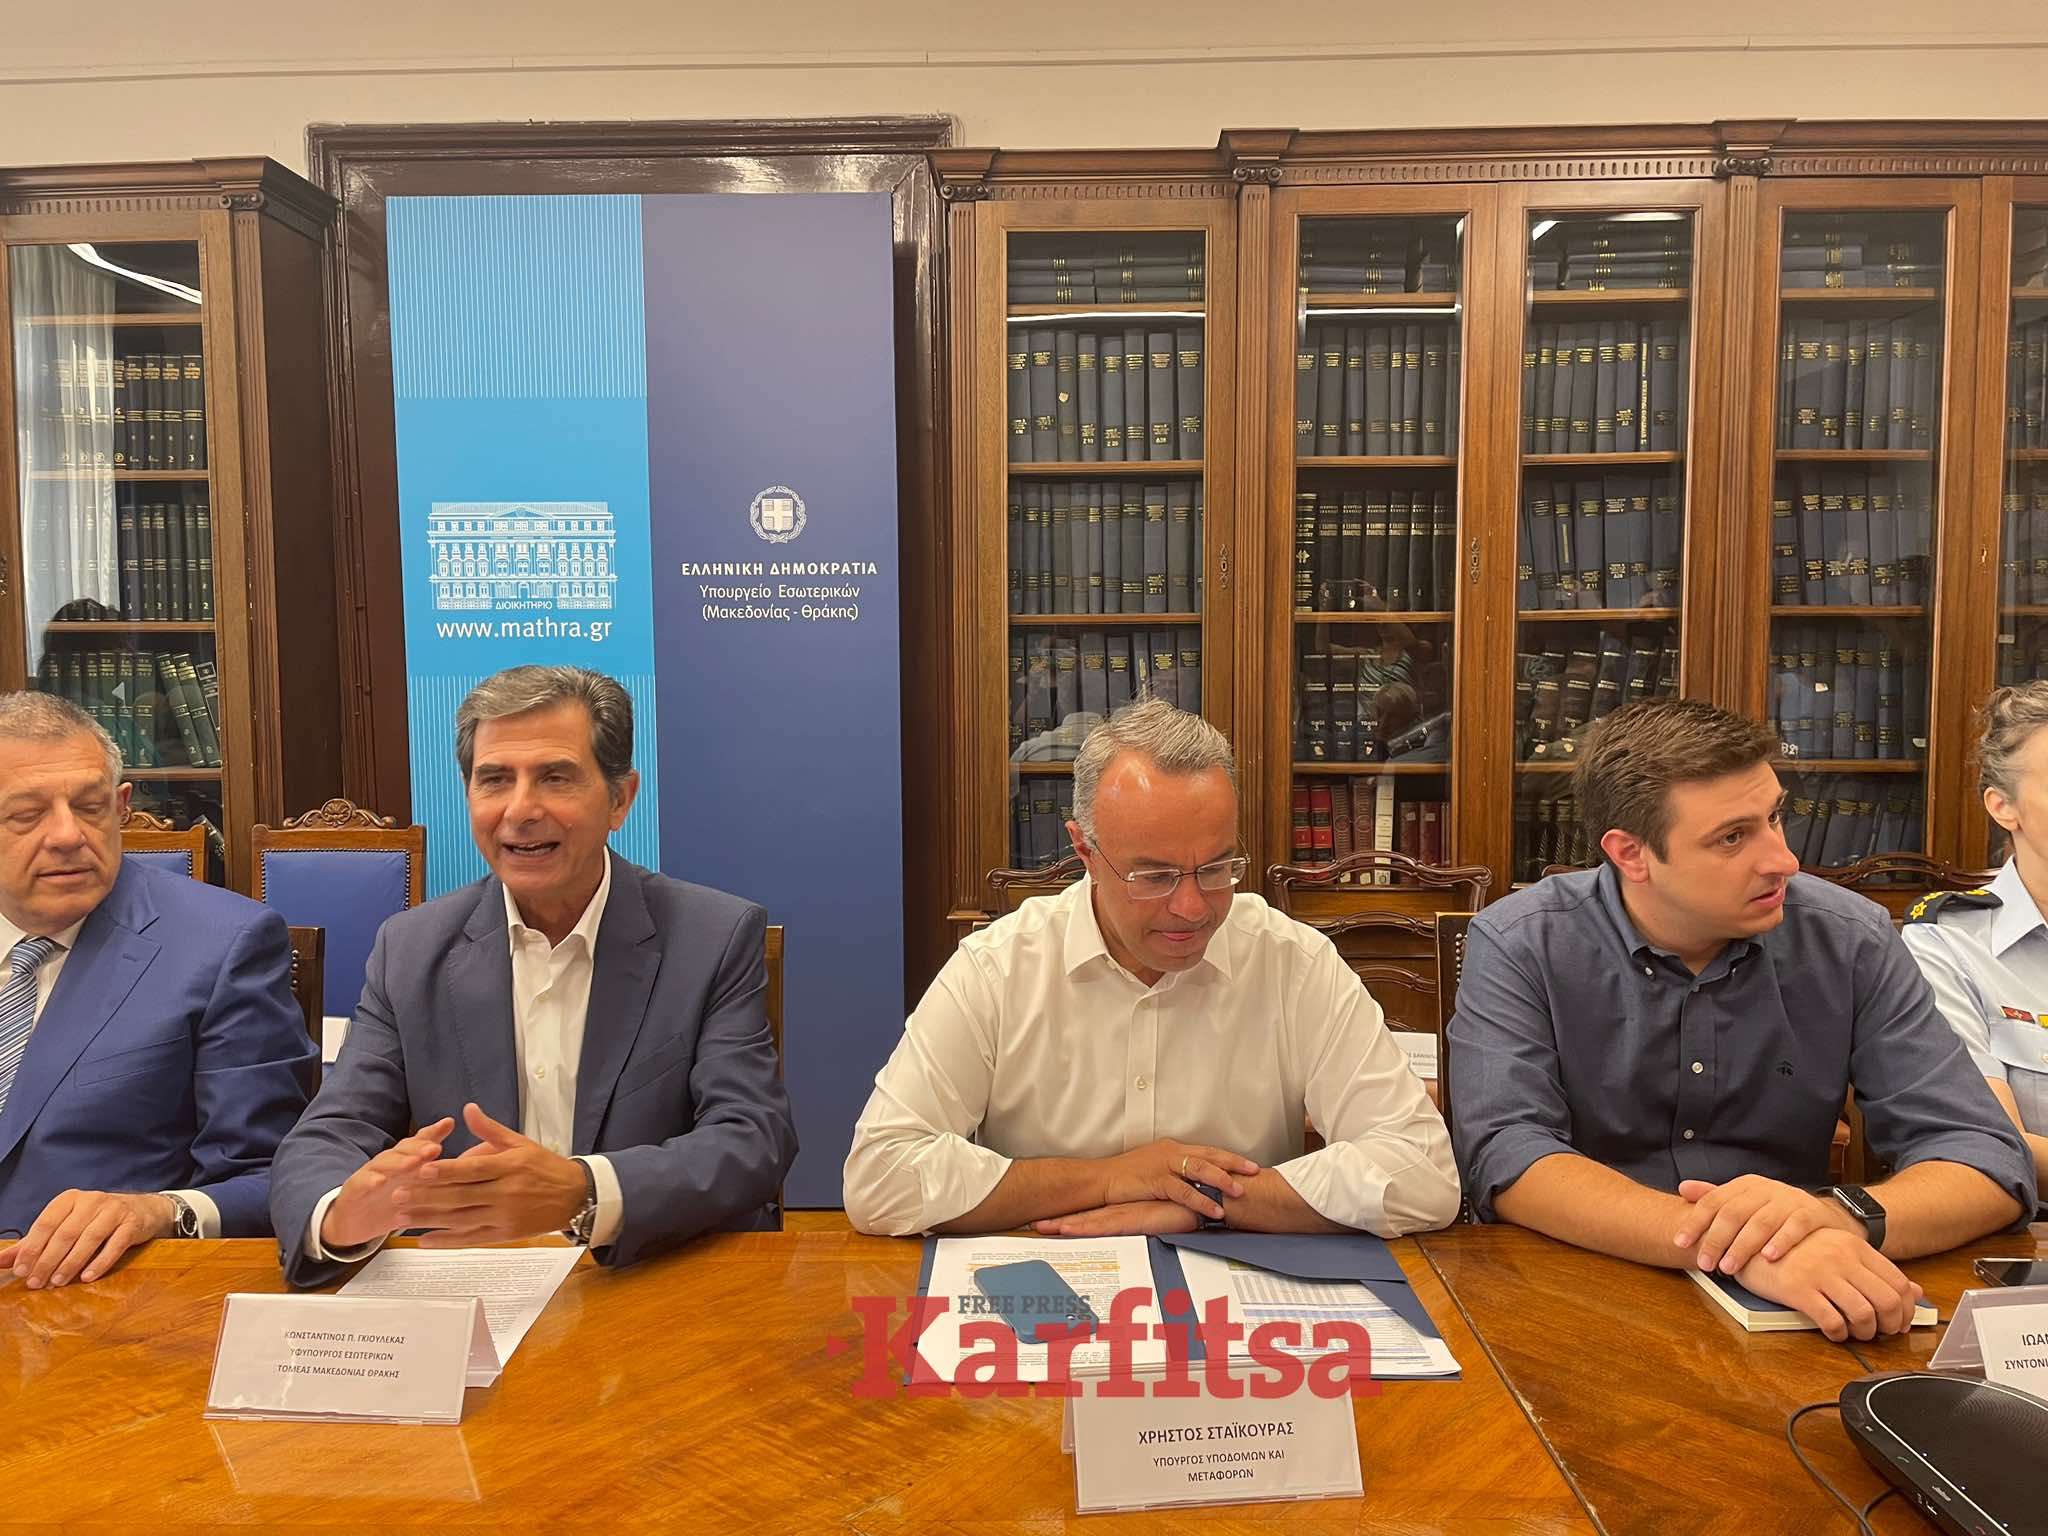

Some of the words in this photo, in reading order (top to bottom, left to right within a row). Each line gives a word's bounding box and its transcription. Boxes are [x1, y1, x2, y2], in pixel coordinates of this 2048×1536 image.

[681, 562, 763, 576] ΕΛΛΗΝΙΚΗ
[770, 562, 878, 575] ΔΗΜΟΚΡΑΤΙΑ
[699, 583, 772, 601] Υπουργείο
[778, 582, 860, 600] Εσωτερικών
[495, 601, 553, 610] ΔΙΟΙΚΗΤΗΡΙΟ
[702, 604, 790, 622] (Μακεδονίας
[801, 604, 859, 622] Θράκης)
[436, 616, 612, 642] www.mathra.gr
[358, 1334, 406, 1344] ΓΚΙΟΥΛΕΚΑΣ
[344, 1351, 394, 1360] ΕΣΩΤΕΡΙΚΩΝ
[278, 1364, 311, 1374] ΤΟΜΕΑΣ
[312, 1366, 366, 1376] ΜΑΚΕΔΟΝΙΑΣ
[1138, 1427, 1204, 1444] ΧΡΗΣΤΟΣ
[1207, 1421, 1294, 1440] ΣΤΑΪΚΟΥΡΑΣ
[1153, 1454, 1204, 1468] ΥΠΟΥΡΓΟΣ
[1206, 1450, 1266, 1464] ΥΠΟΔΟΜΩΝ
[1268, 1450, 1285, 1460] ΚΑΙ
[1188, 1469, 1254, 1482] ΜΕΤΑΦΟΡΩΝ
